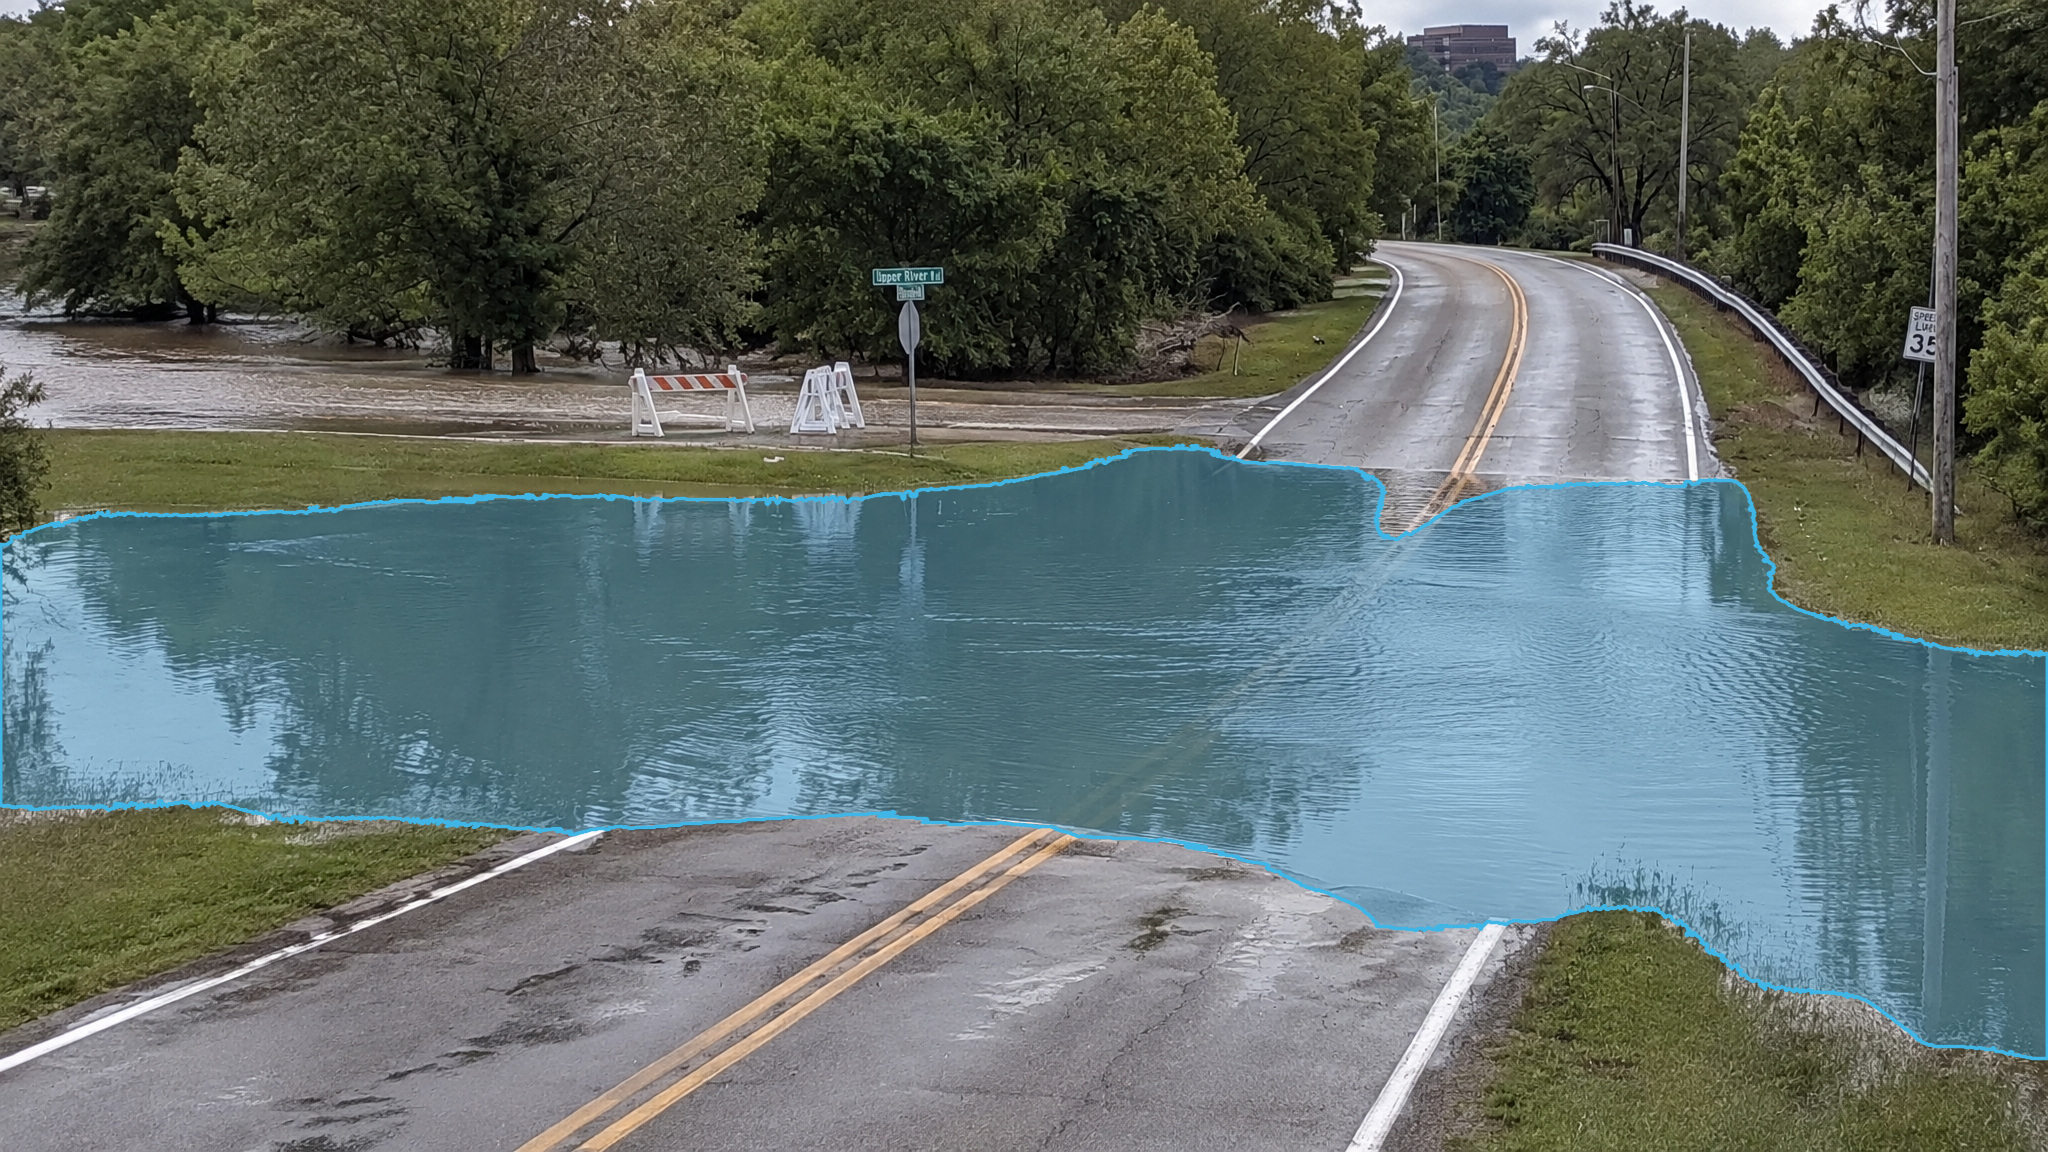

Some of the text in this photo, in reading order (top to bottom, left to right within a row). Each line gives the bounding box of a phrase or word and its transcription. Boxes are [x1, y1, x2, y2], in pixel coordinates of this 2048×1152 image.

[876, 270, 902, 283] Upper
[904, 270, 928, 282] River
[1913, 311, 1936, 322] SPEE
[1909, 334, 1936, 355] 35
